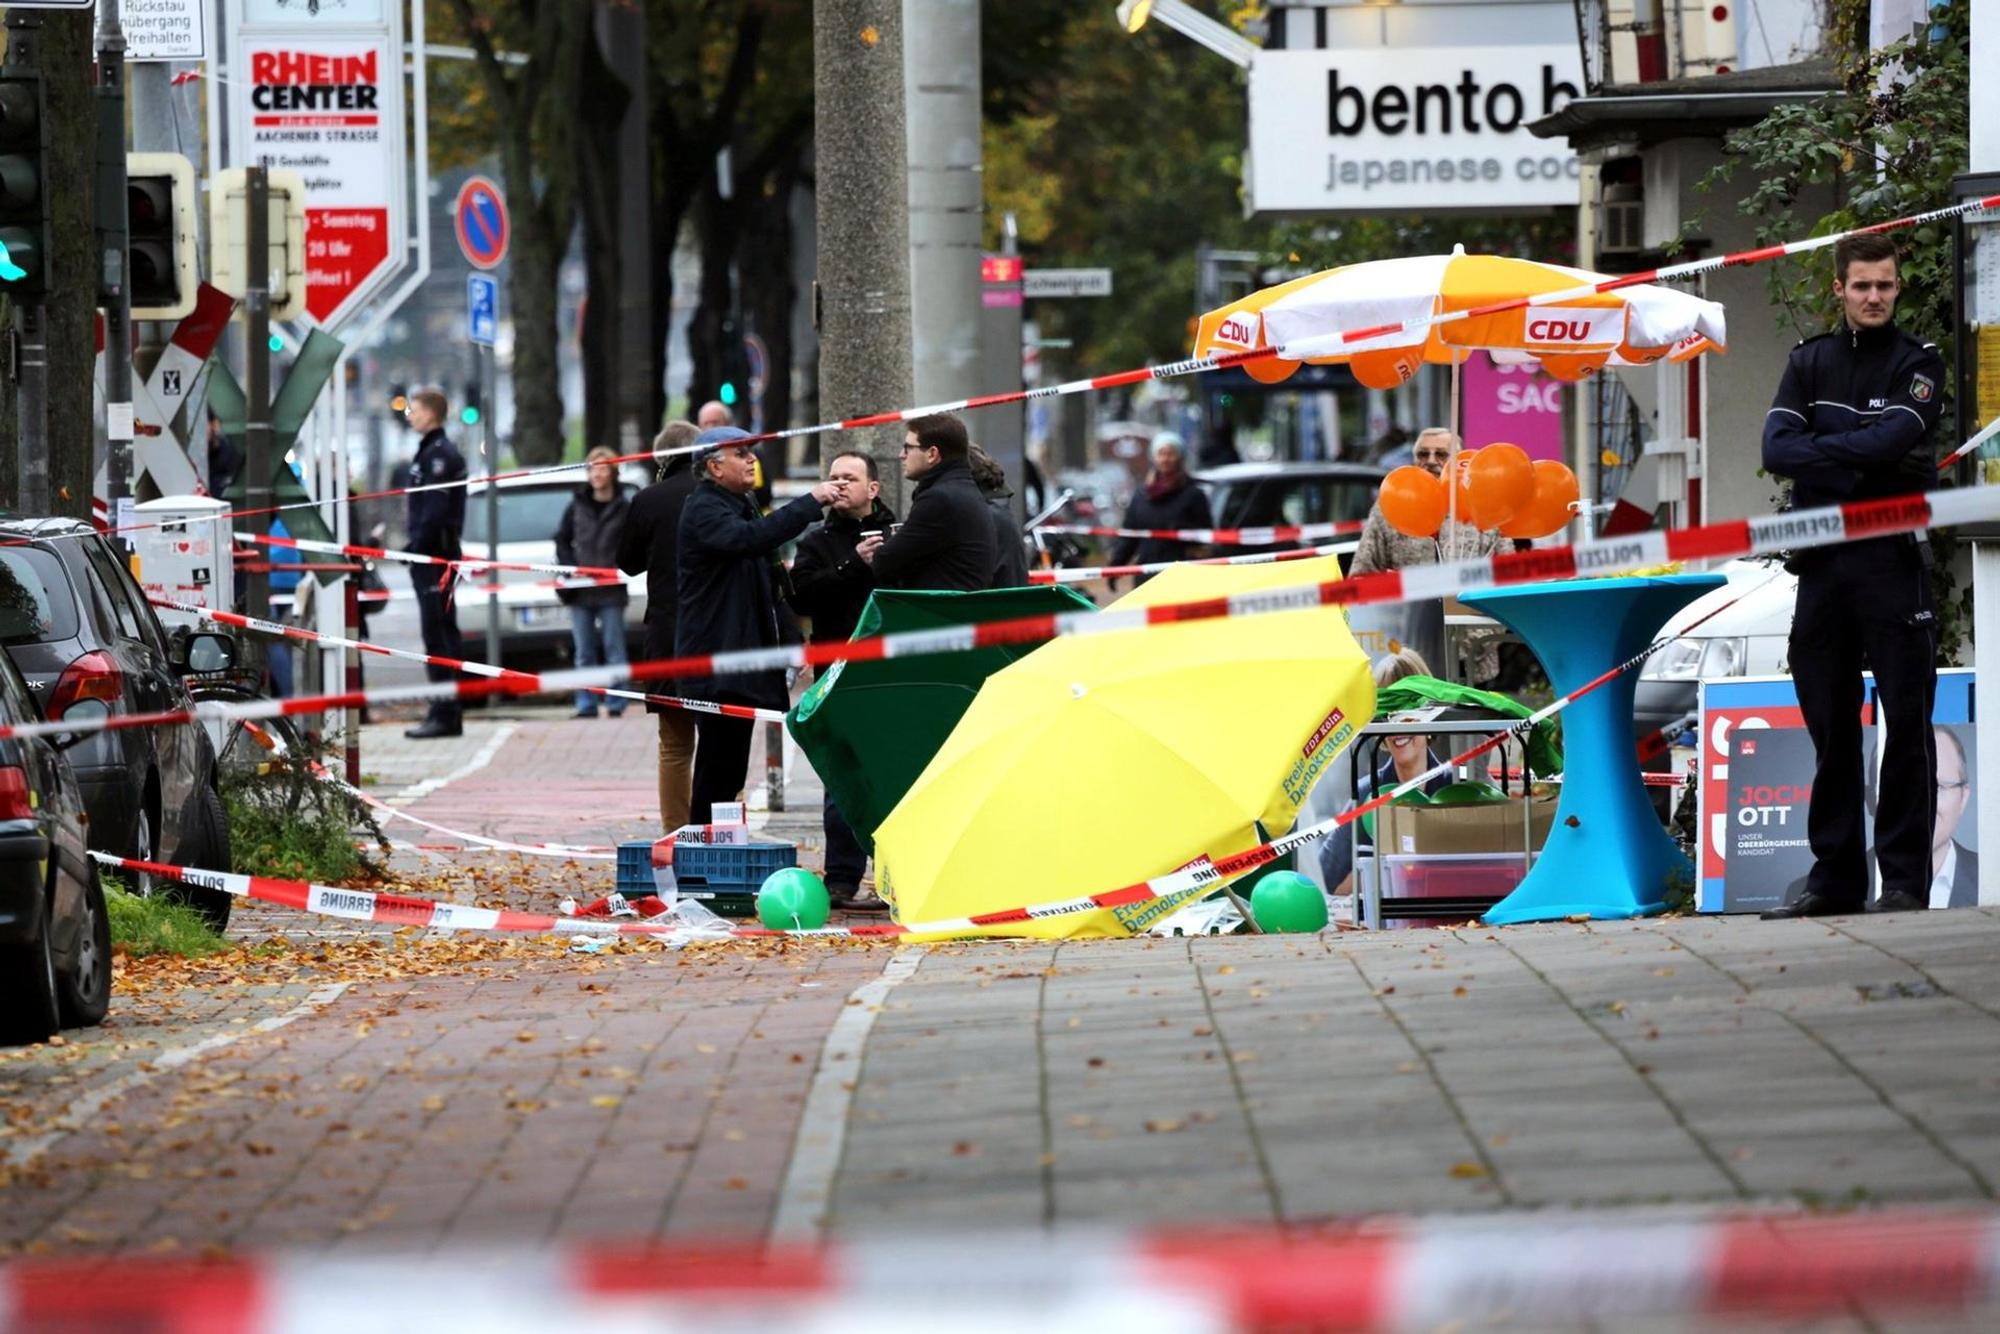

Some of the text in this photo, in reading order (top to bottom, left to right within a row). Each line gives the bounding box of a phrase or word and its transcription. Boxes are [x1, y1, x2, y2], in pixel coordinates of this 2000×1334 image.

[128, 32, 192, 45] freihalten
[252, 49, 377, 86] RHEIN
[251, 84, 379, 112] CENTER
[1327, 69, 1524, 136] bento
[255, 130, 379, 143] AACHENER STRASSE
[1325, 153, 1503, 192] japanese
[1218, 319, 1249, 344] CDU
[1529, 320, 1591, 341] CDU
[1304, 712, 1341, 756] FDP Köln
[1290, 722, 1354, 807] Demokraten
[1737, 806, 1792, 827] OTT
[1737, 833, 1763, 842] UNSER
